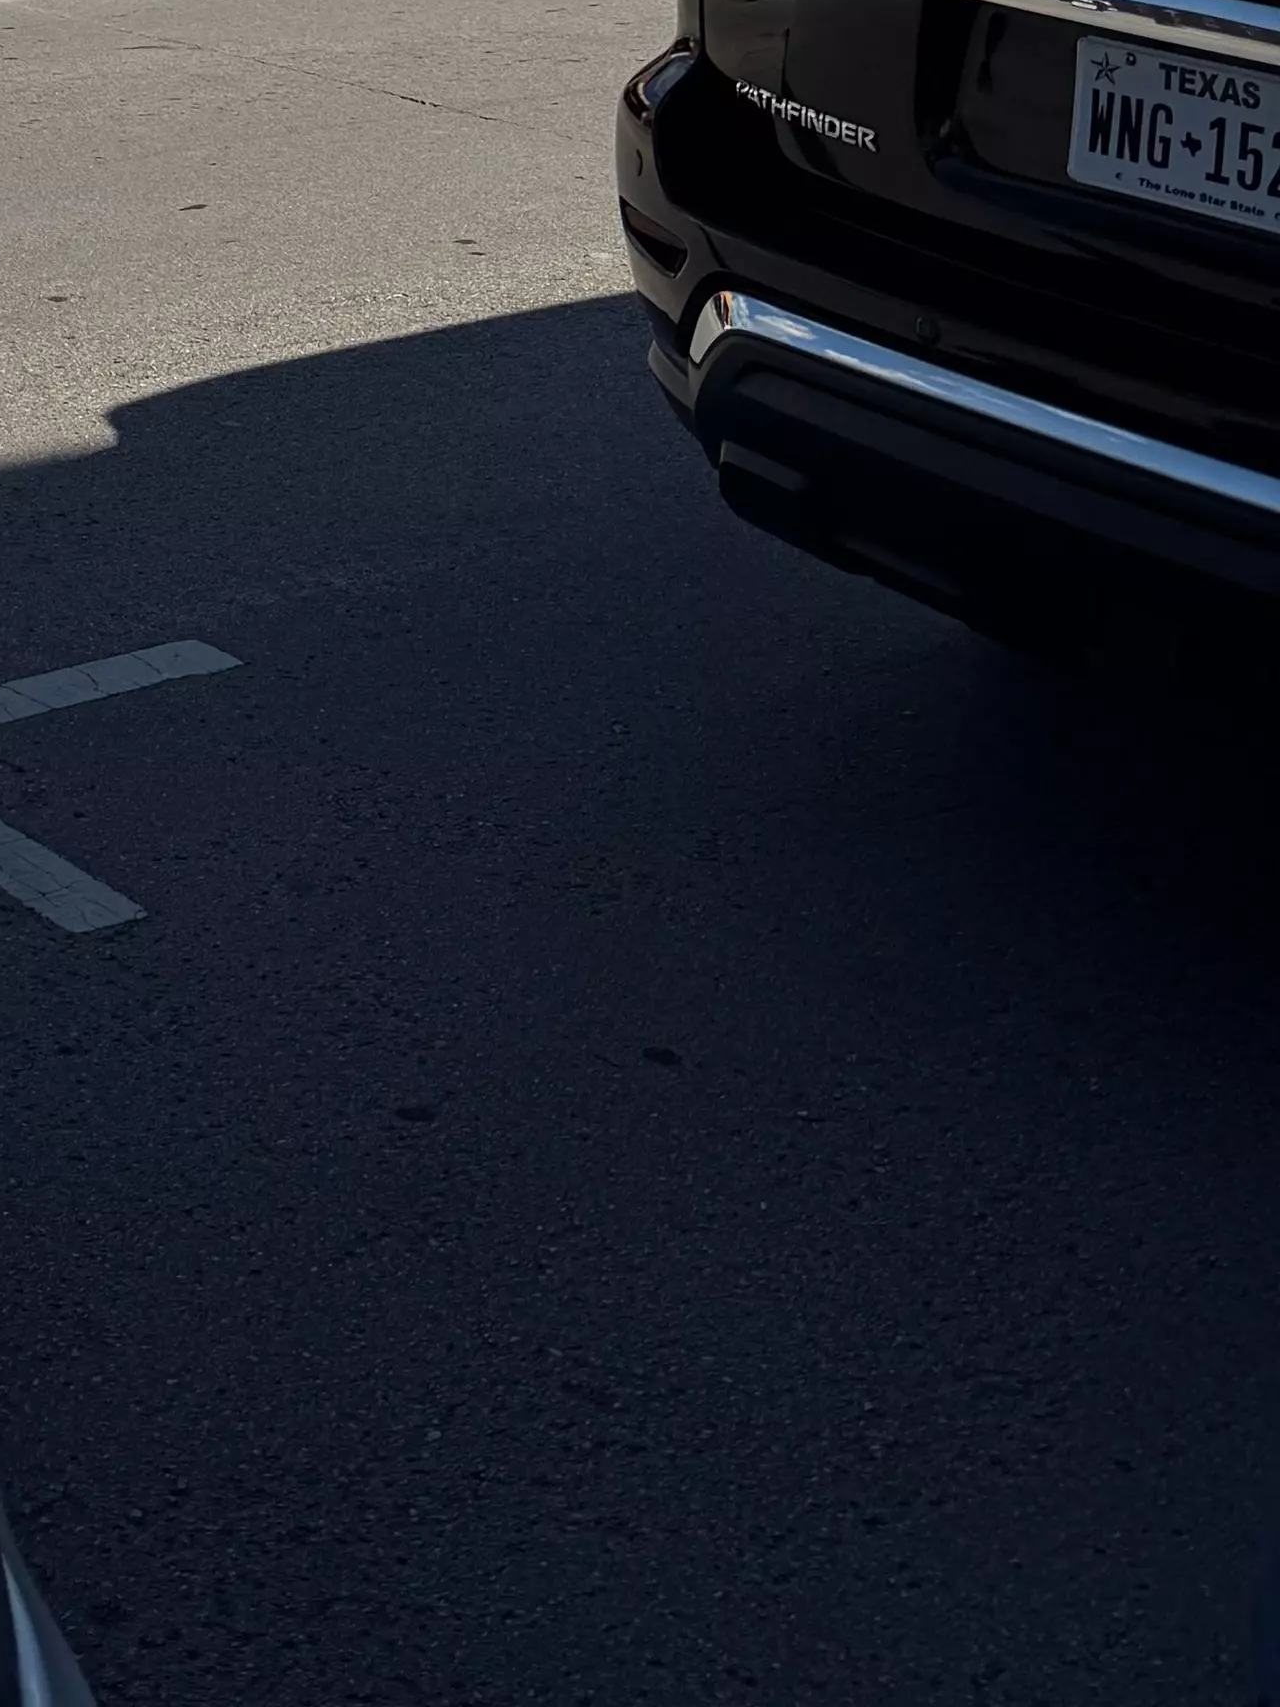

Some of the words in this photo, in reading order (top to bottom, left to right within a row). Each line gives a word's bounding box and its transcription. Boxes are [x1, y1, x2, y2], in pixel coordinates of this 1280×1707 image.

[735, 78, 877, 153] PATHFINDER
[1158, 61, 1262, 110] TEXAS
[1088, 88, 1174, 170] WNG
[1138, 176, 1161, 192] The
[1164, 183, 1196, 201] Lone
[1198, 191, 1227, 209] Star
[1229, 199, 1266, 218] State
